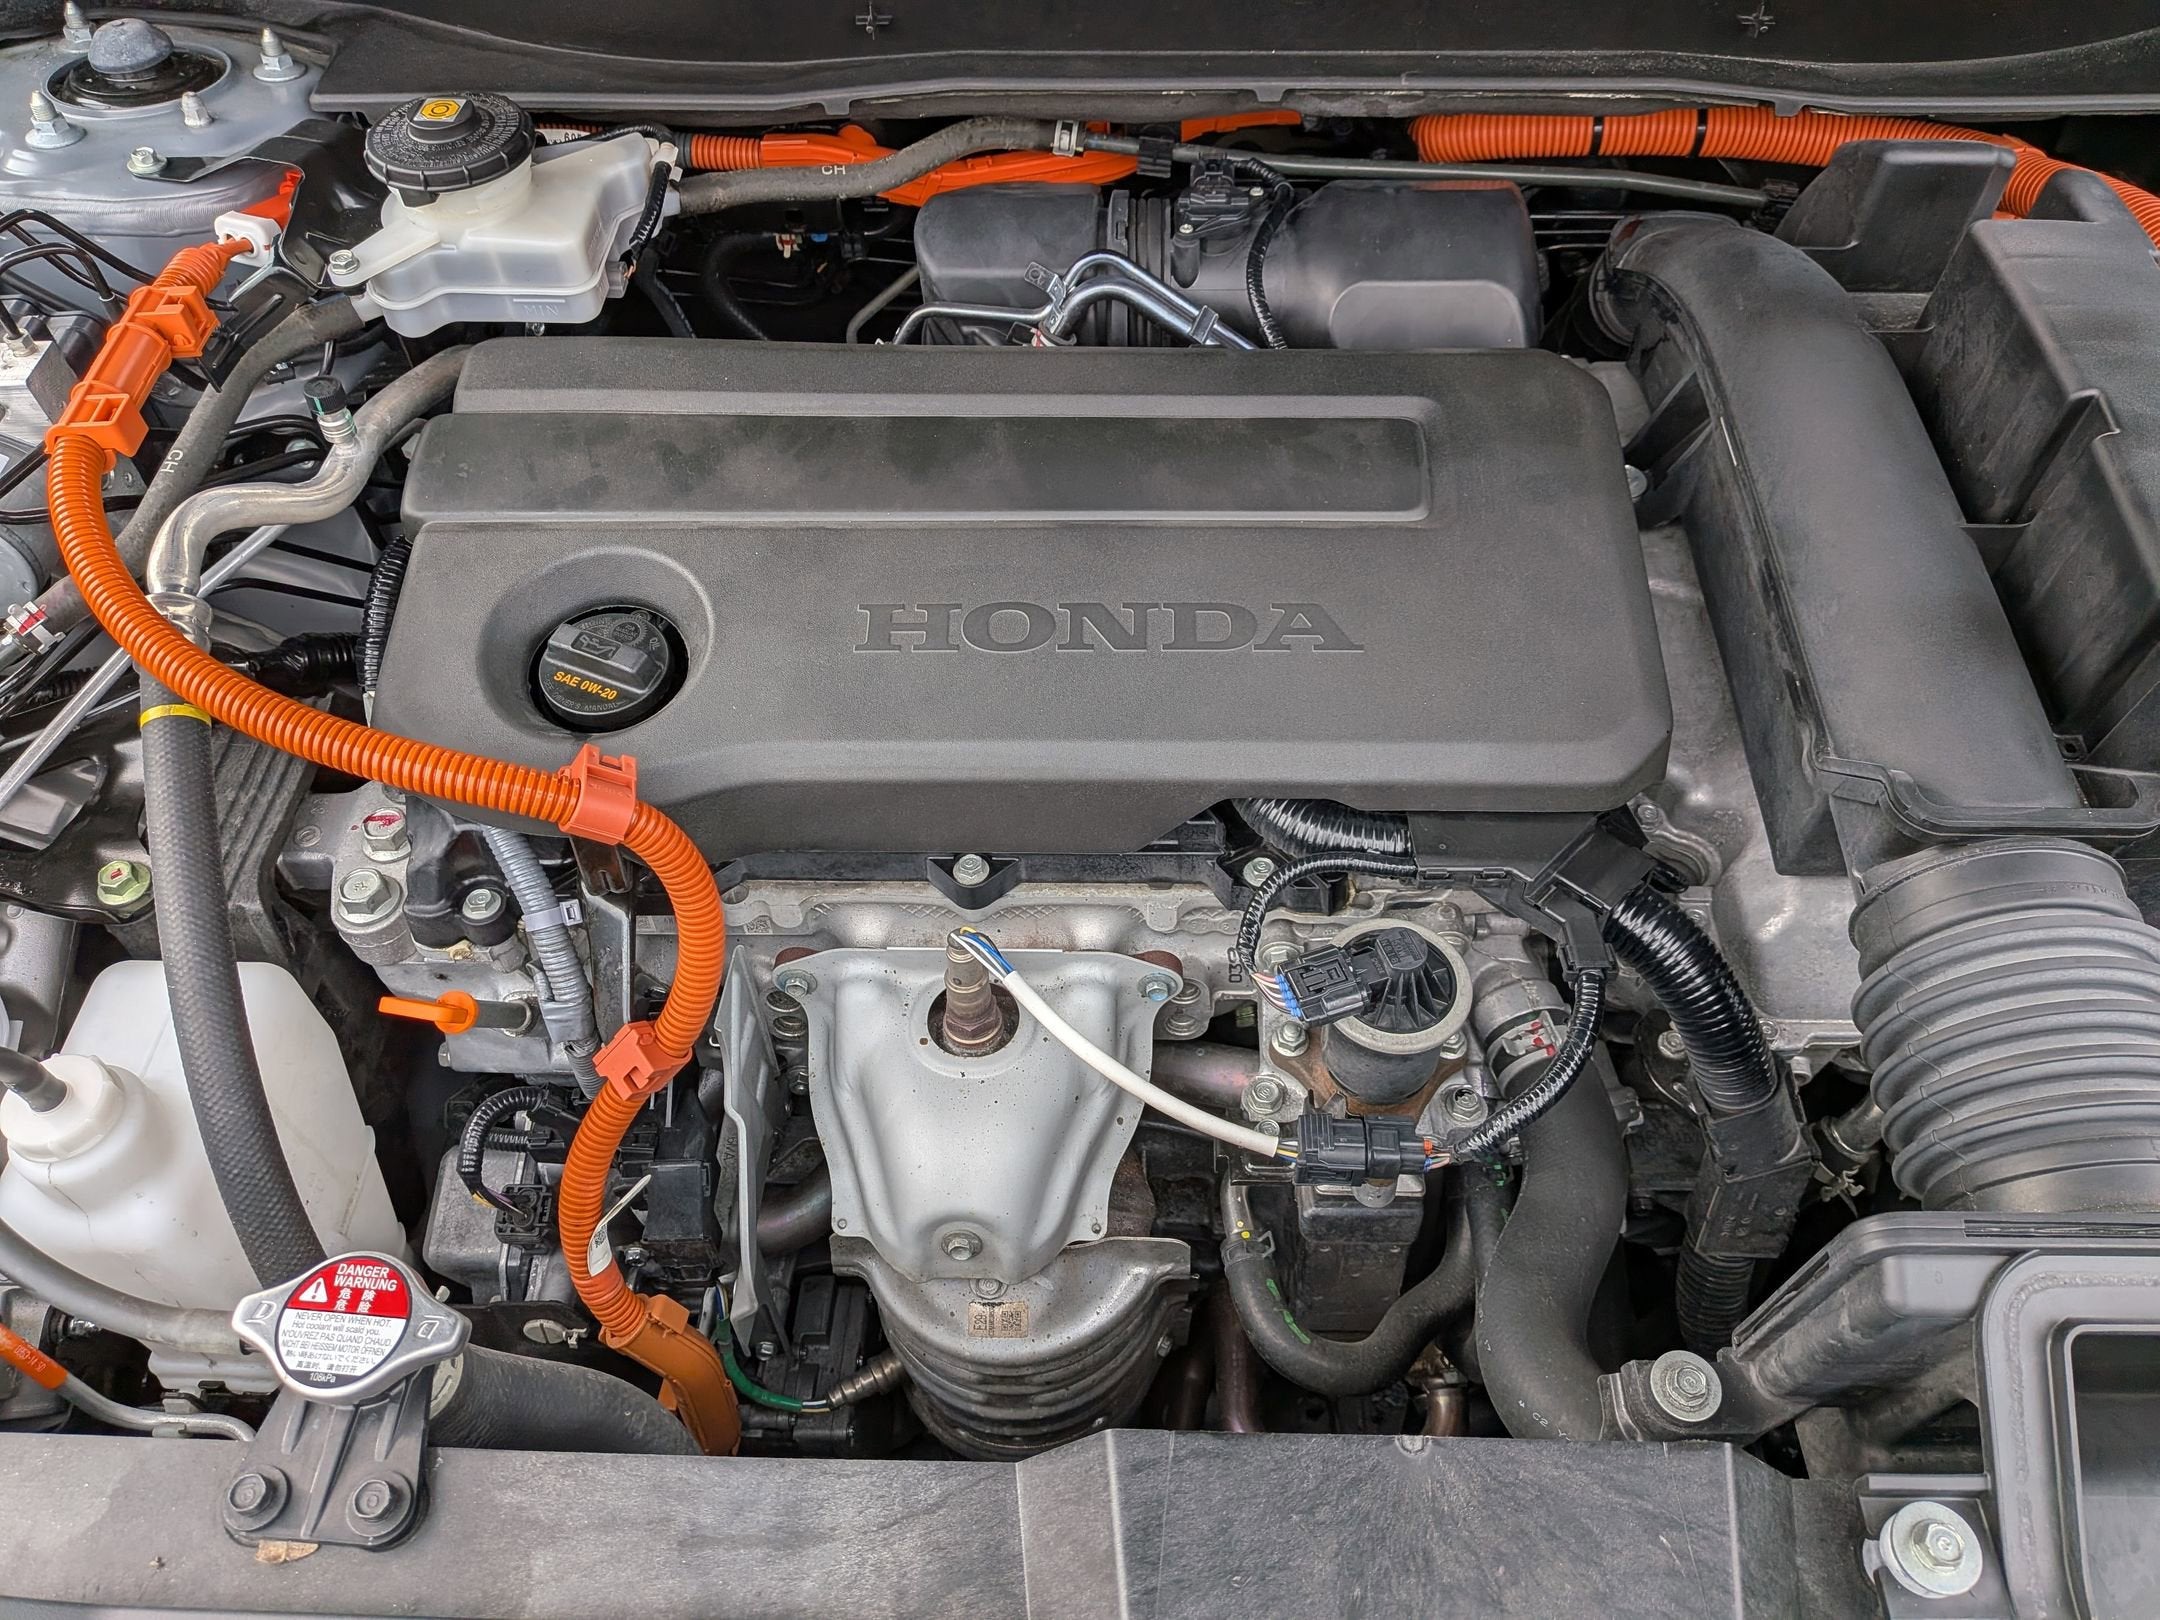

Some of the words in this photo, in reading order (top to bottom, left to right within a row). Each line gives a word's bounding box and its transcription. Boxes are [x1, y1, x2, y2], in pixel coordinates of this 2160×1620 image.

[821, 165, 846, 175] CH
[160, 450, 183, 473] CH
[853, 601, 1365, 653] HONDA
[553, 671, 581, 687] SAE
[580, 680, 618, 700] 0W-20
[583, 702, 618, 711] MANUAL
[337, 1263, 390, 1278] DANGER
[334, 1275, 398, 1291] WARNUNG
[292, 1320, 305, 1329] Hot
[306, 1321, 331, 1331] coolant
[333, 1324, 345, 1332] will
[345, 1325, 365, 1335] scald
[295, 1311, 322, 1323] NEVER
[324, 1314, 346, 1325] OPEN
[348, 1315, 372, 1326] WHEN
[373, 1318, 392, 1328] HOT.
[281, 1329, 319, 1340] N'OUVREZ
[320, 1332, 336, 1342] PAS
[336, 1334, 364, 1345] QUAND
[338, 1344, 360, 1354] MOTOR
